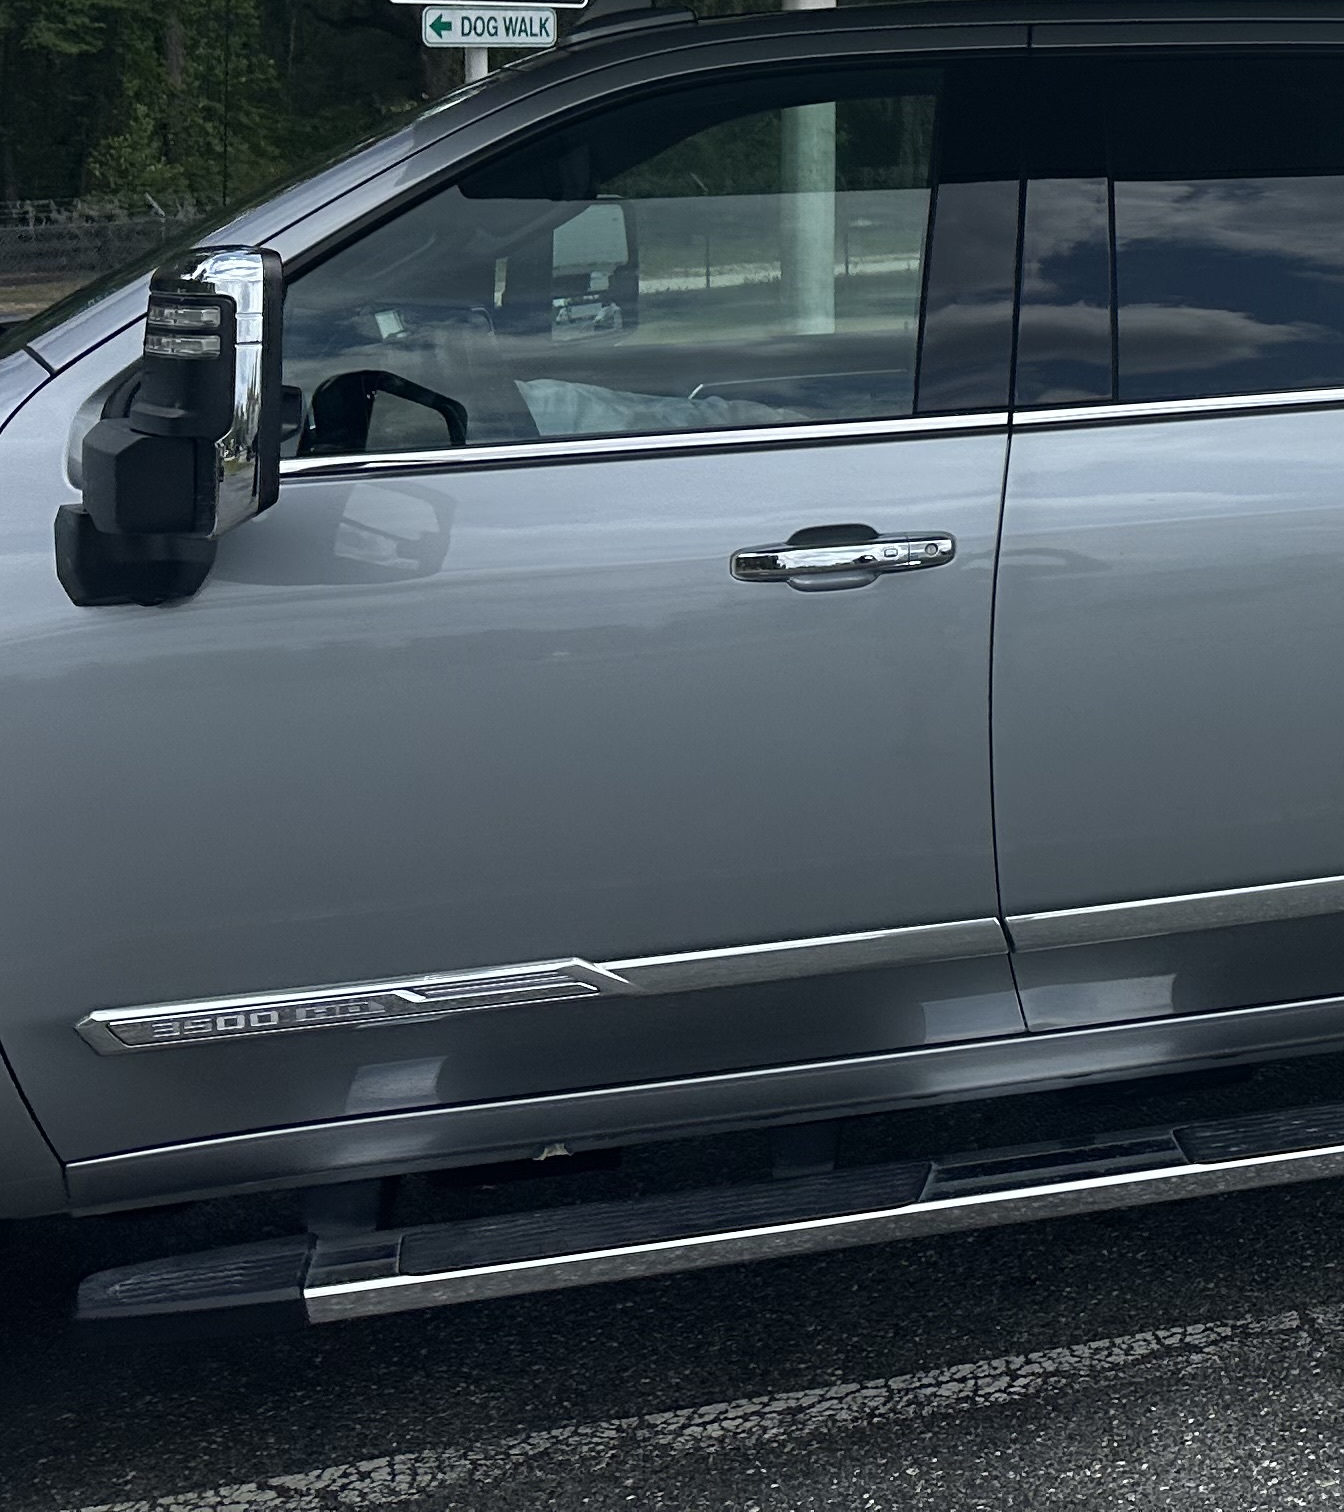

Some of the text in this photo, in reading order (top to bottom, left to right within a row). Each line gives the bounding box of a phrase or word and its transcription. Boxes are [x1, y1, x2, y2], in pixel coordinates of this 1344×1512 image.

[461, 16, 550, 38] DOG WALK
[151, 1010, 280, 1038] 3500
